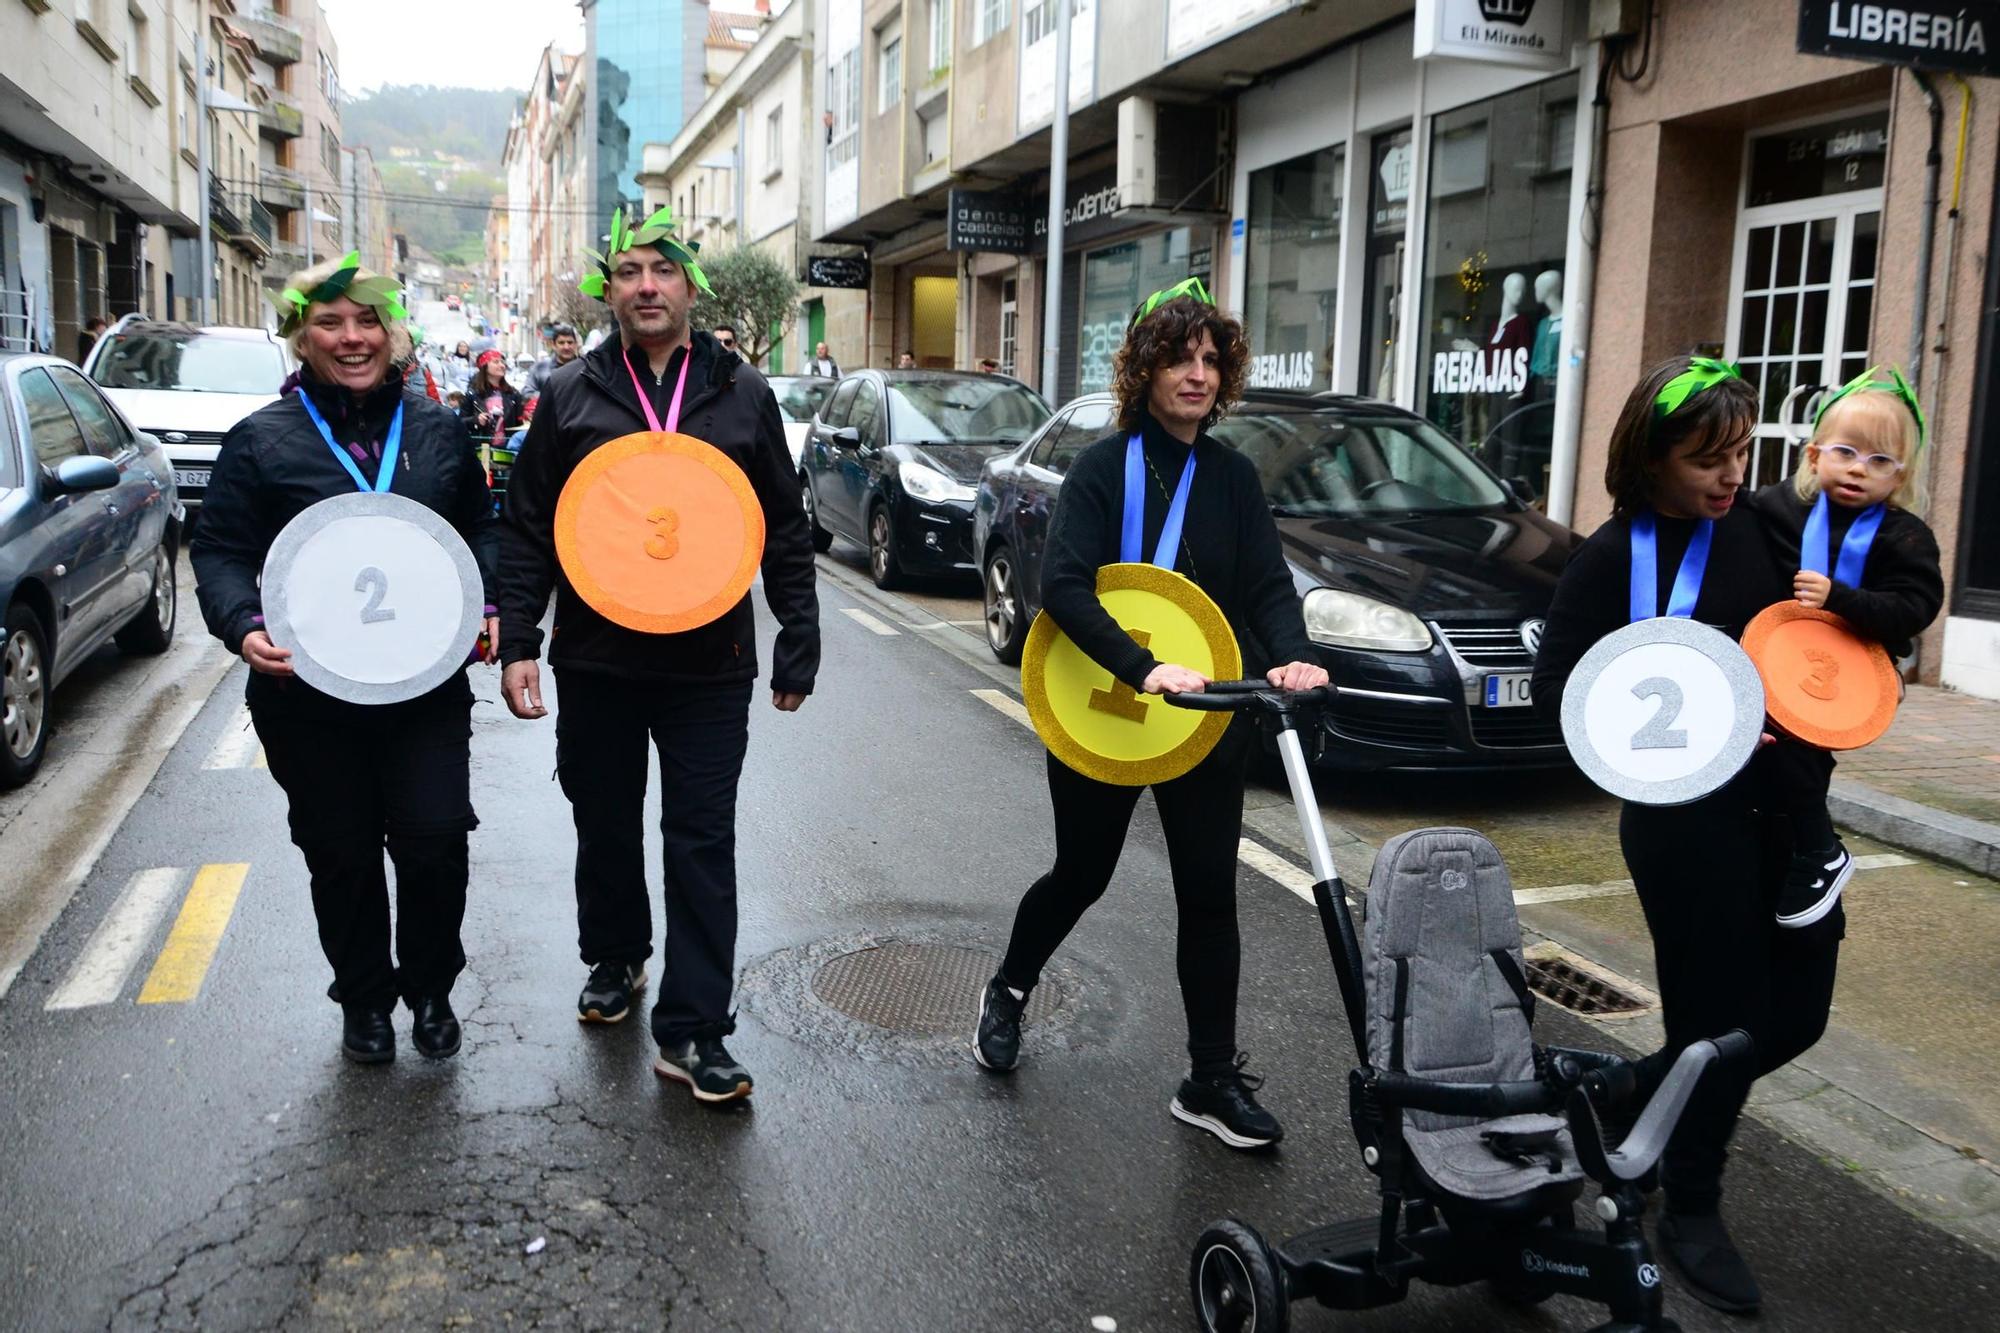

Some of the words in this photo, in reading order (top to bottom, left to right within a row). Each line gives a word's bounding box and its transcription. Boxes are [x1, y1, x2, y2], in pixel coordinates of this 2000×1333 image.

[1462, 25, 1479, 40] Eli
[1485, 29, 1545, 49] Miranda
[1828, 1, 1986, 54] LIBRERÍA
[1844, 161, 1859, 182] 12
[958, 208, 1026, 224] dental
[1077, 184, 1122, 219] denta
[957, 221, 1025, 237] castelao
[1251, 351, 1313, 388] REBAJAS
[1433, 347, 1528, 394] REBAJAS
[644, 507, 679, 561] 3
[354, 566, 396, 624] 2
[1507, 678, 1531, 702] 10
[1799, 649, 1840, 701] 3
[1631, 676, 1688, 750] 2
[1545, 1260, 1590, 1278] Kinderkraft
